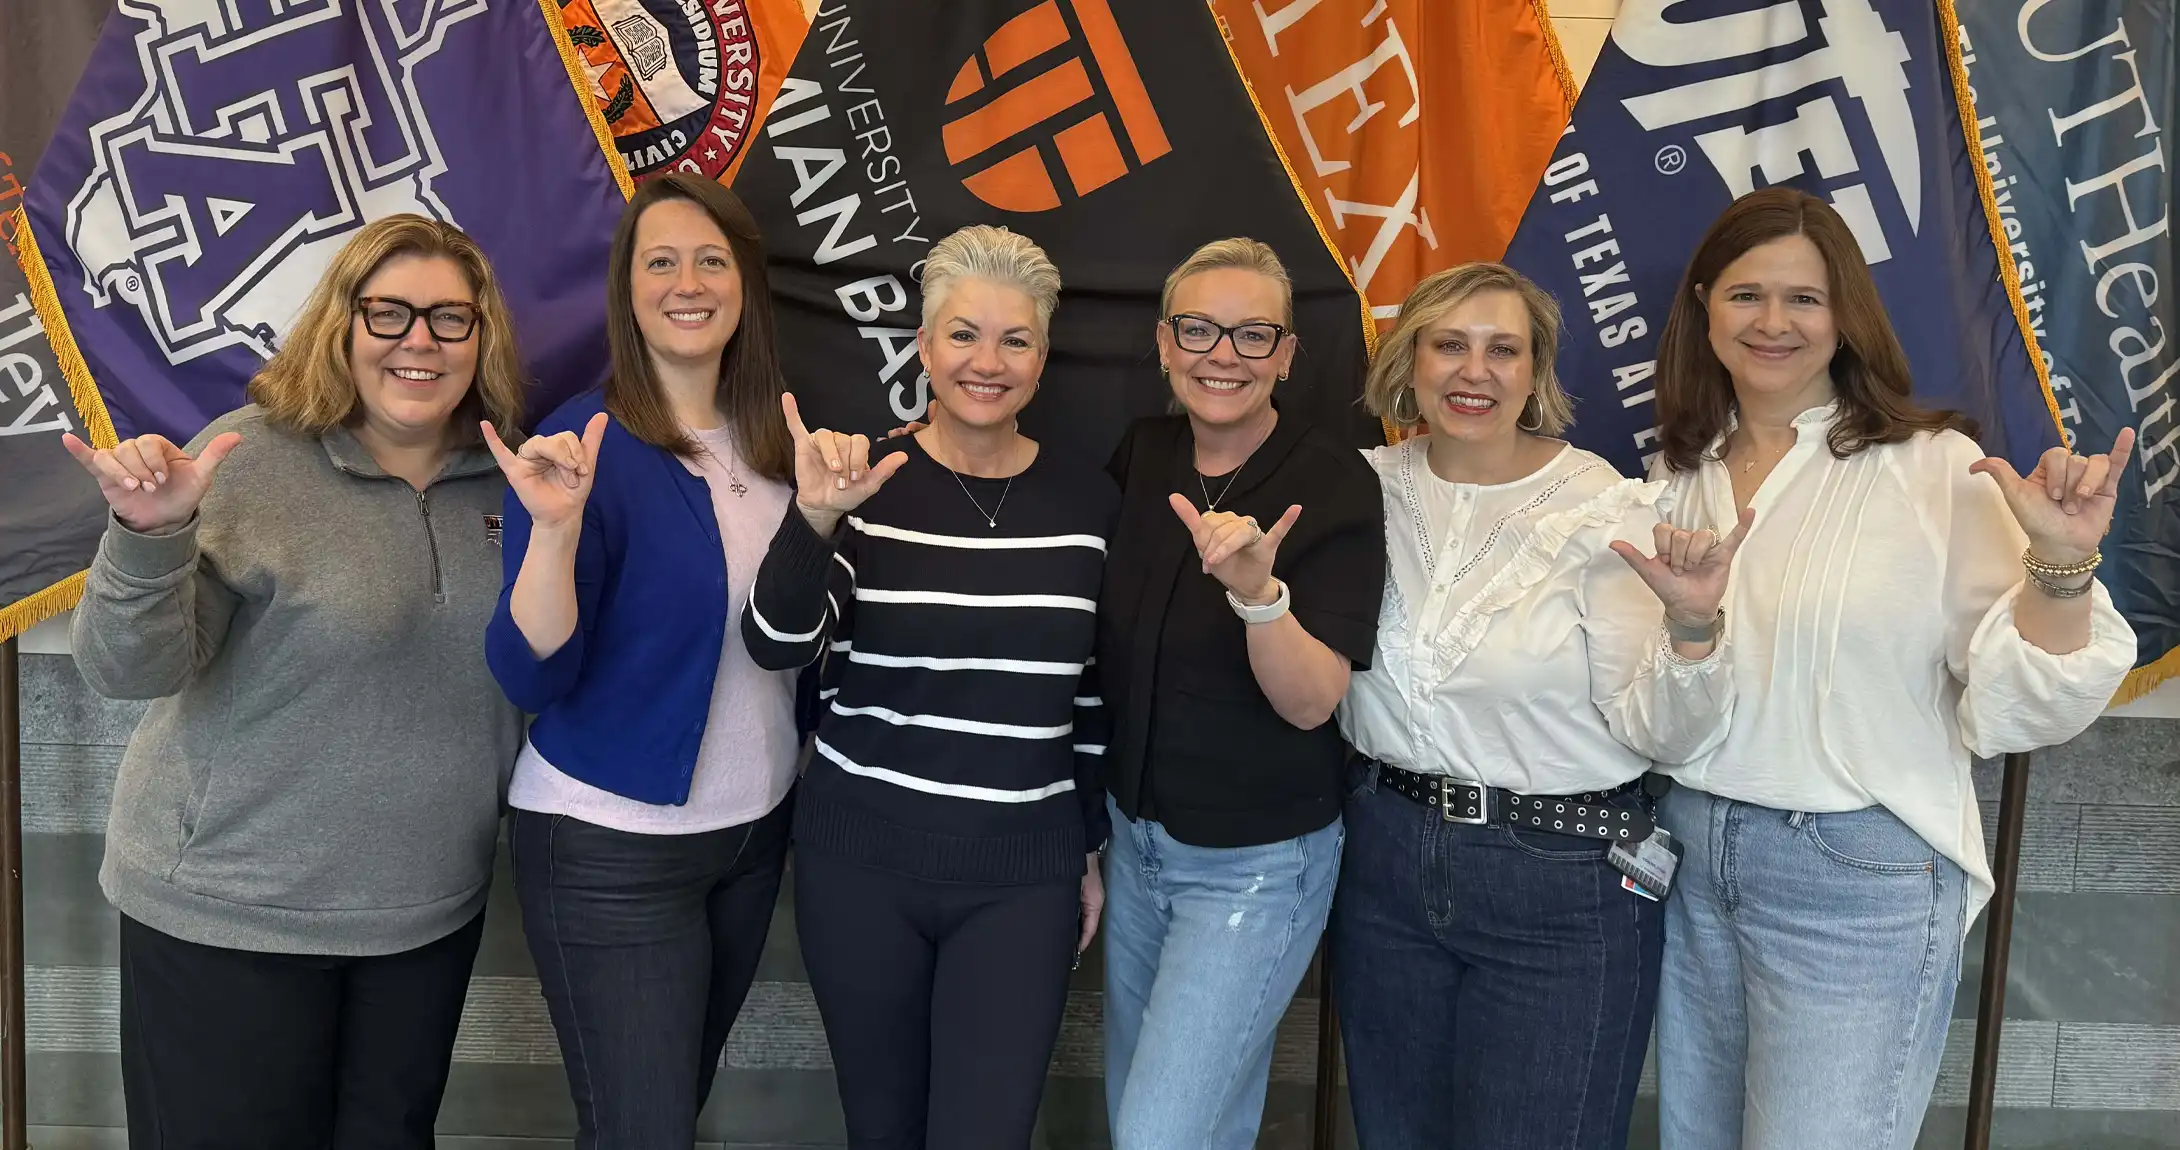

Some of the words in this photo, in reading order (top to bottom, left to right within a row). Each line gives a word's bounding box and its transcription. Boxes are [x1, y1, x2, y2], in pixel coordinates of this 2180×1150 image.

[1544, 152, 1599, 204] OF
[1564, 213, 1649, 348] TEXAS
[2017, 0, 2180, 508] UTHealth
